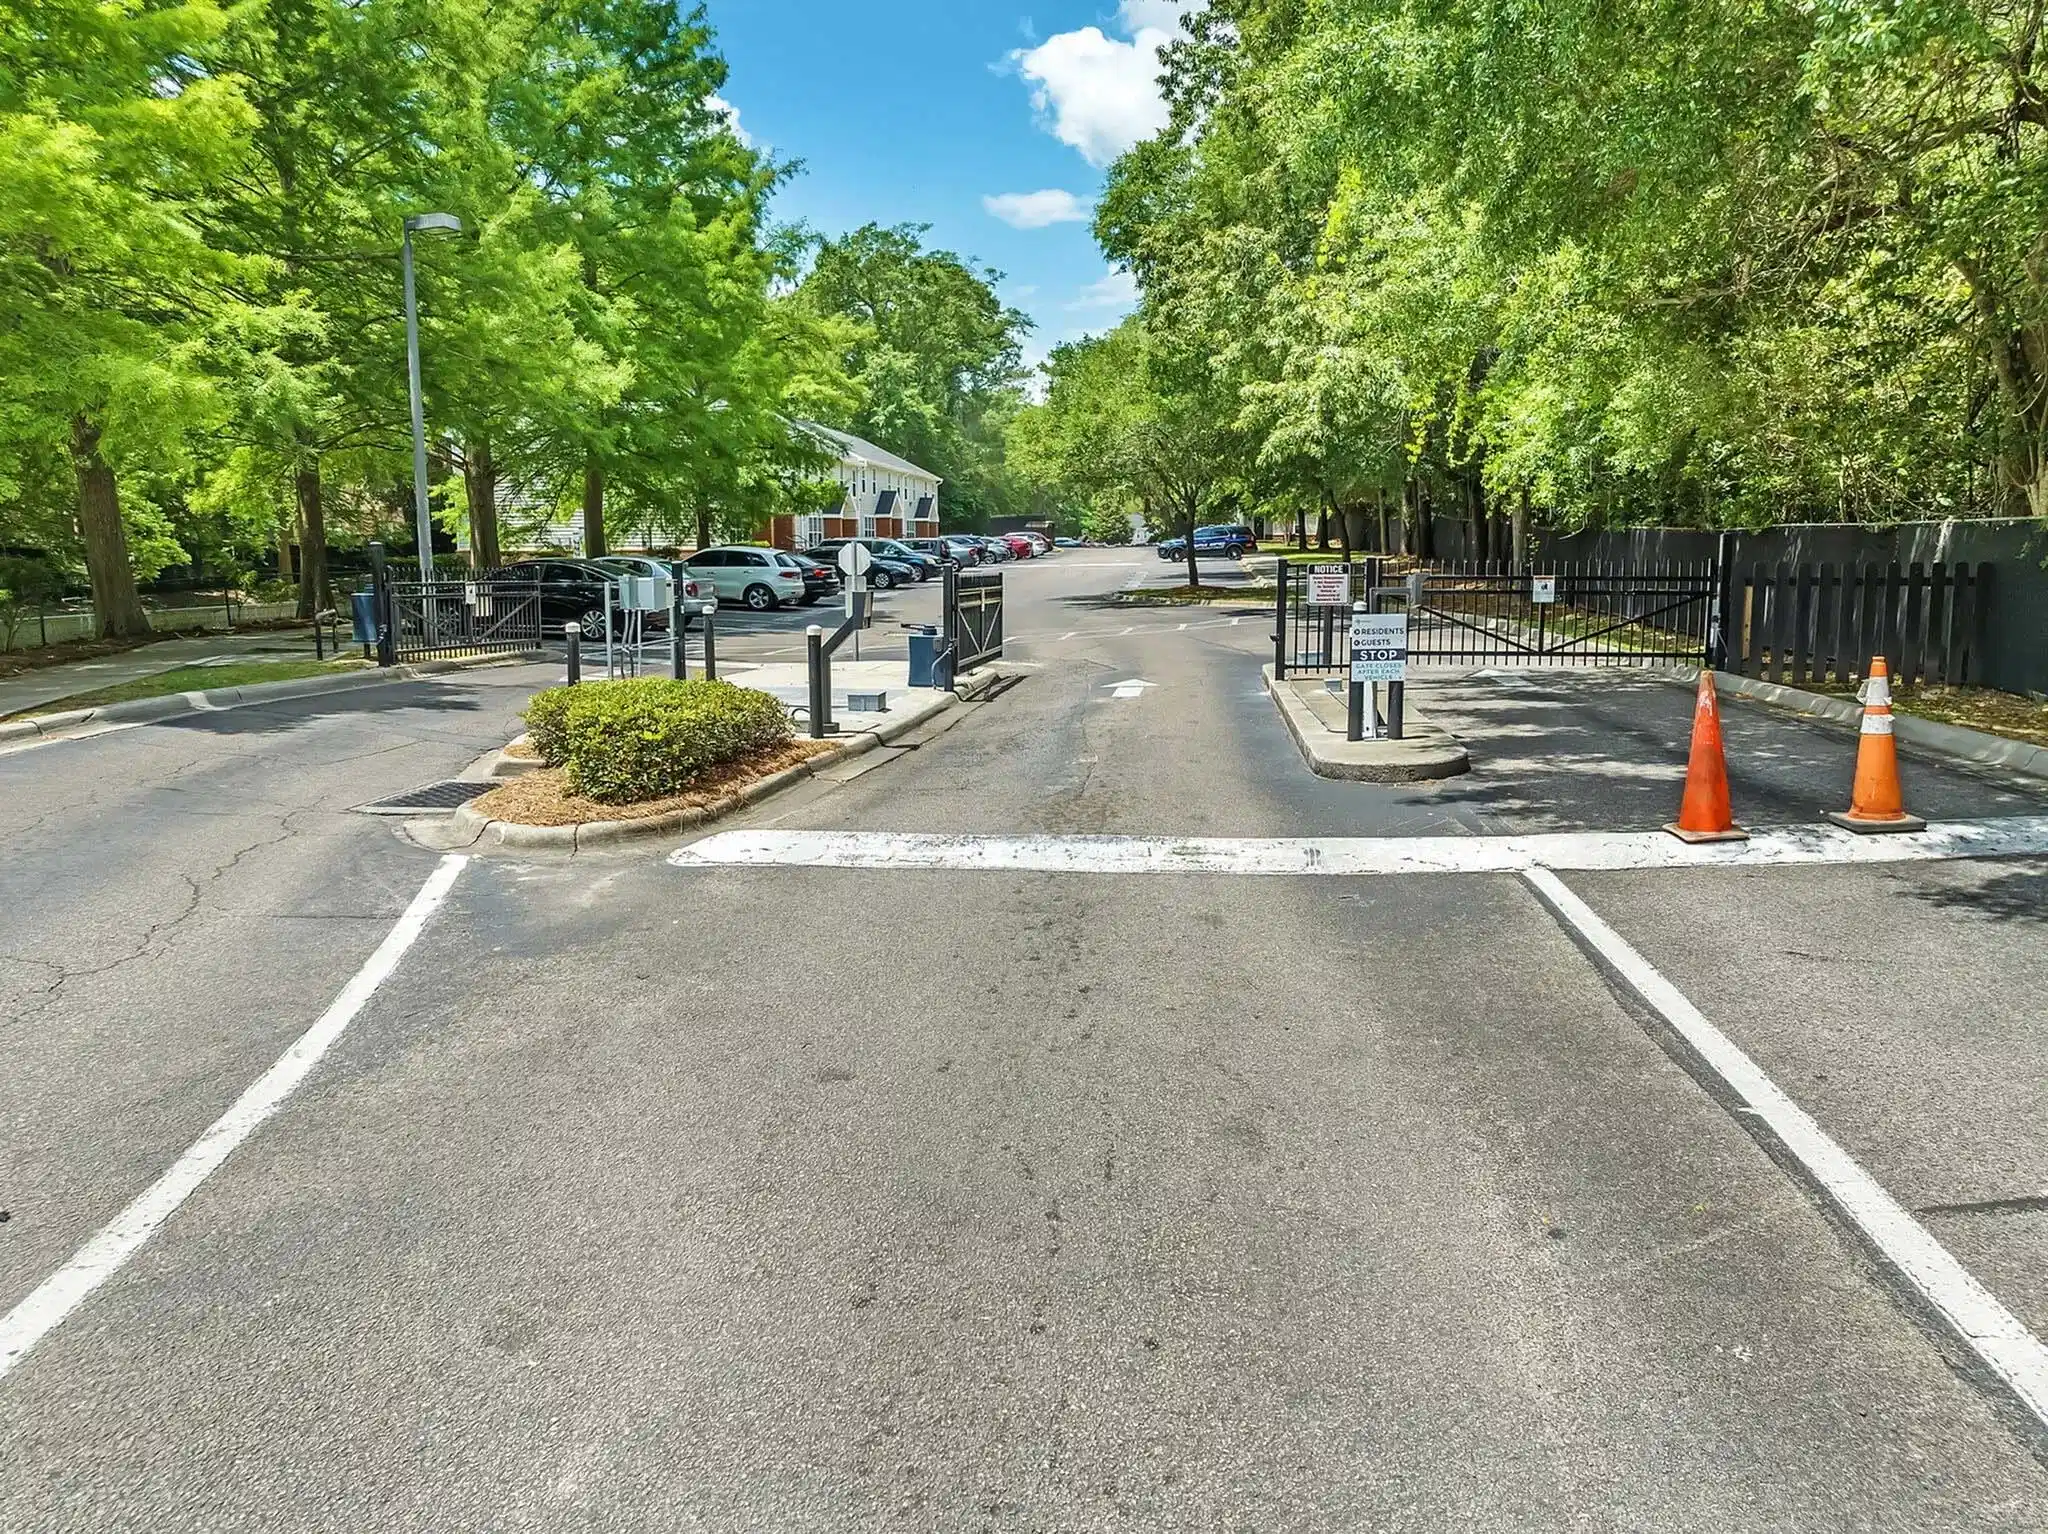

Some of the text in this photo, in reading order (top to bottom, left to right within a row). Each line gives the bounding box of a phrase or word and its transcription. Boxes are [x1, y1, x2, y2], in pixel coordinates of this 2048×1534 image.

[1314, 565, 1343, 574] NOTICE
[1361, 627, 1404, 635] RESIDENTS
[1360, 650, 1397, 660] STOP
